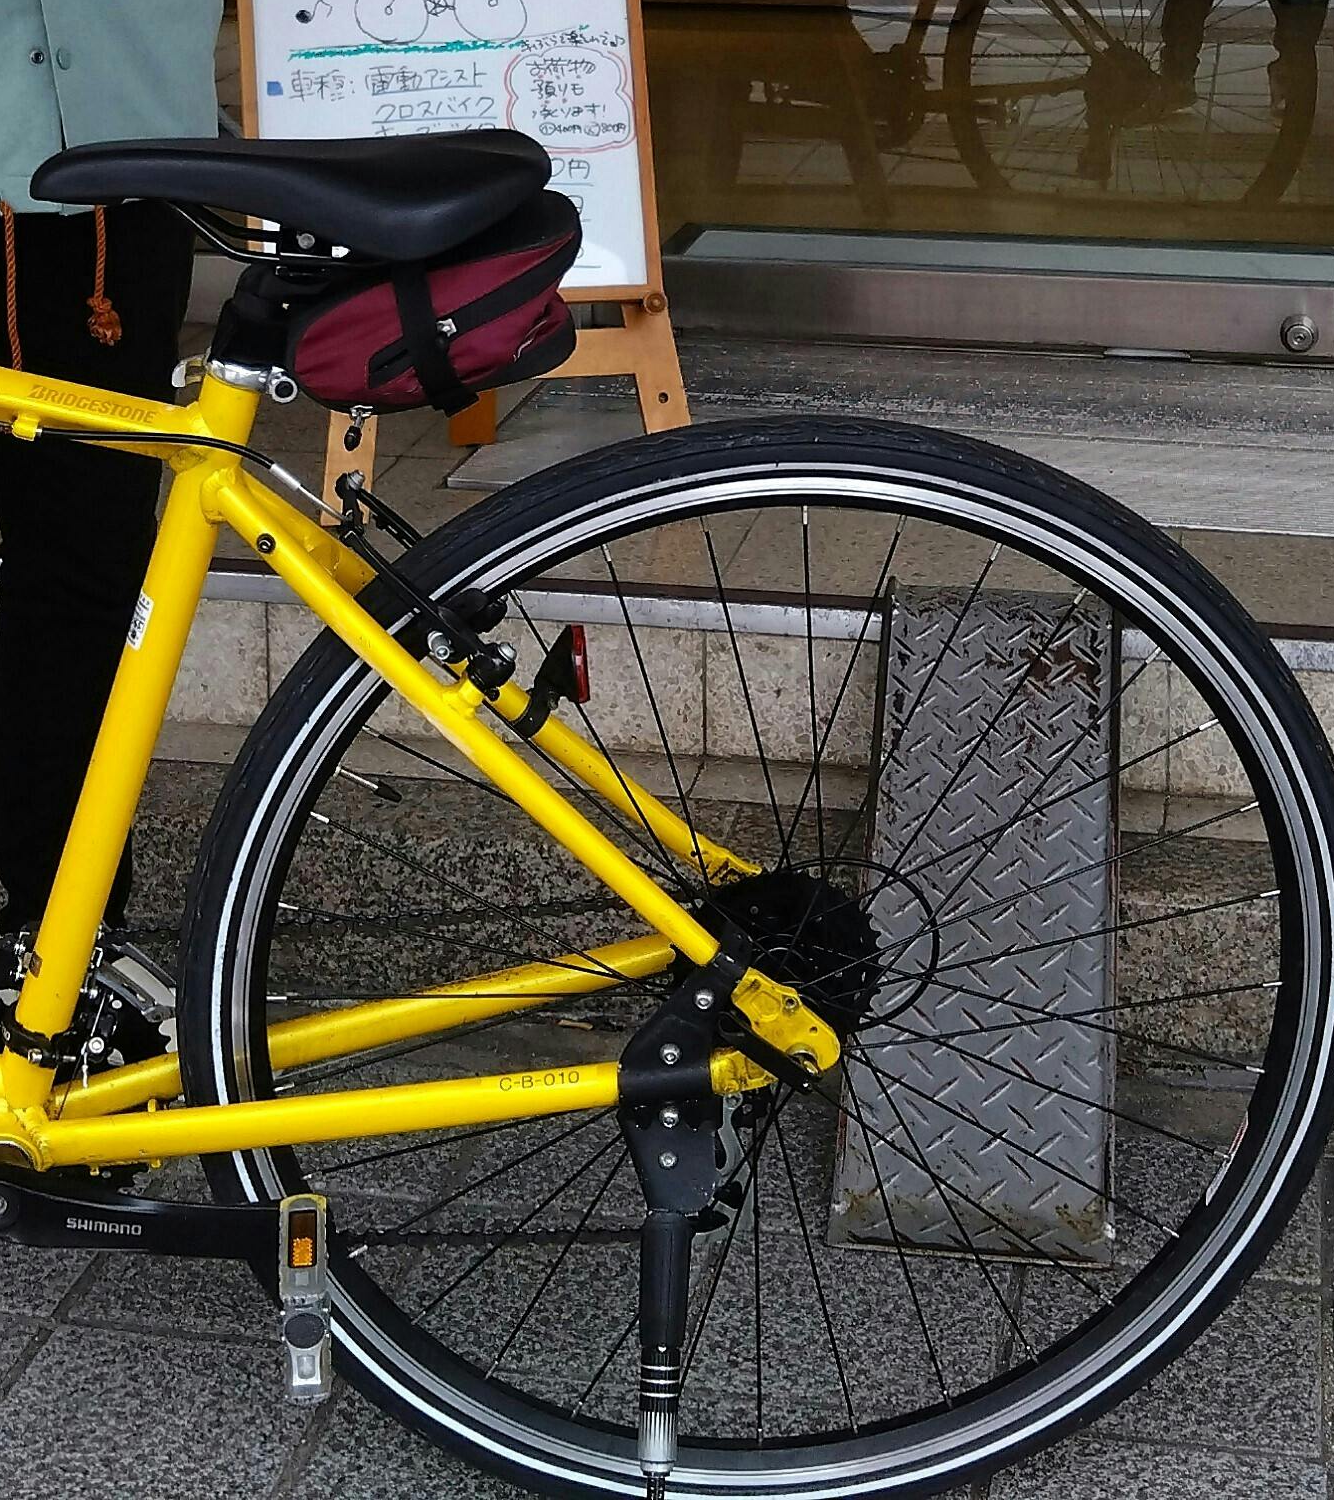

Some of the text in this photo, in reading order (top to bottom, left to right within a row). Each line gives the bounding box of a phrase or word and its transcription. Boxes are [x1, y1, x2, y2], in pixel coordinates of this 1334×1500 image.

[27, 384, 158, 425] BRIDGESTONE
[499, 1069, 580, 1093] C-B-010
[65, 1216, 143, 1236] SHIMANO
